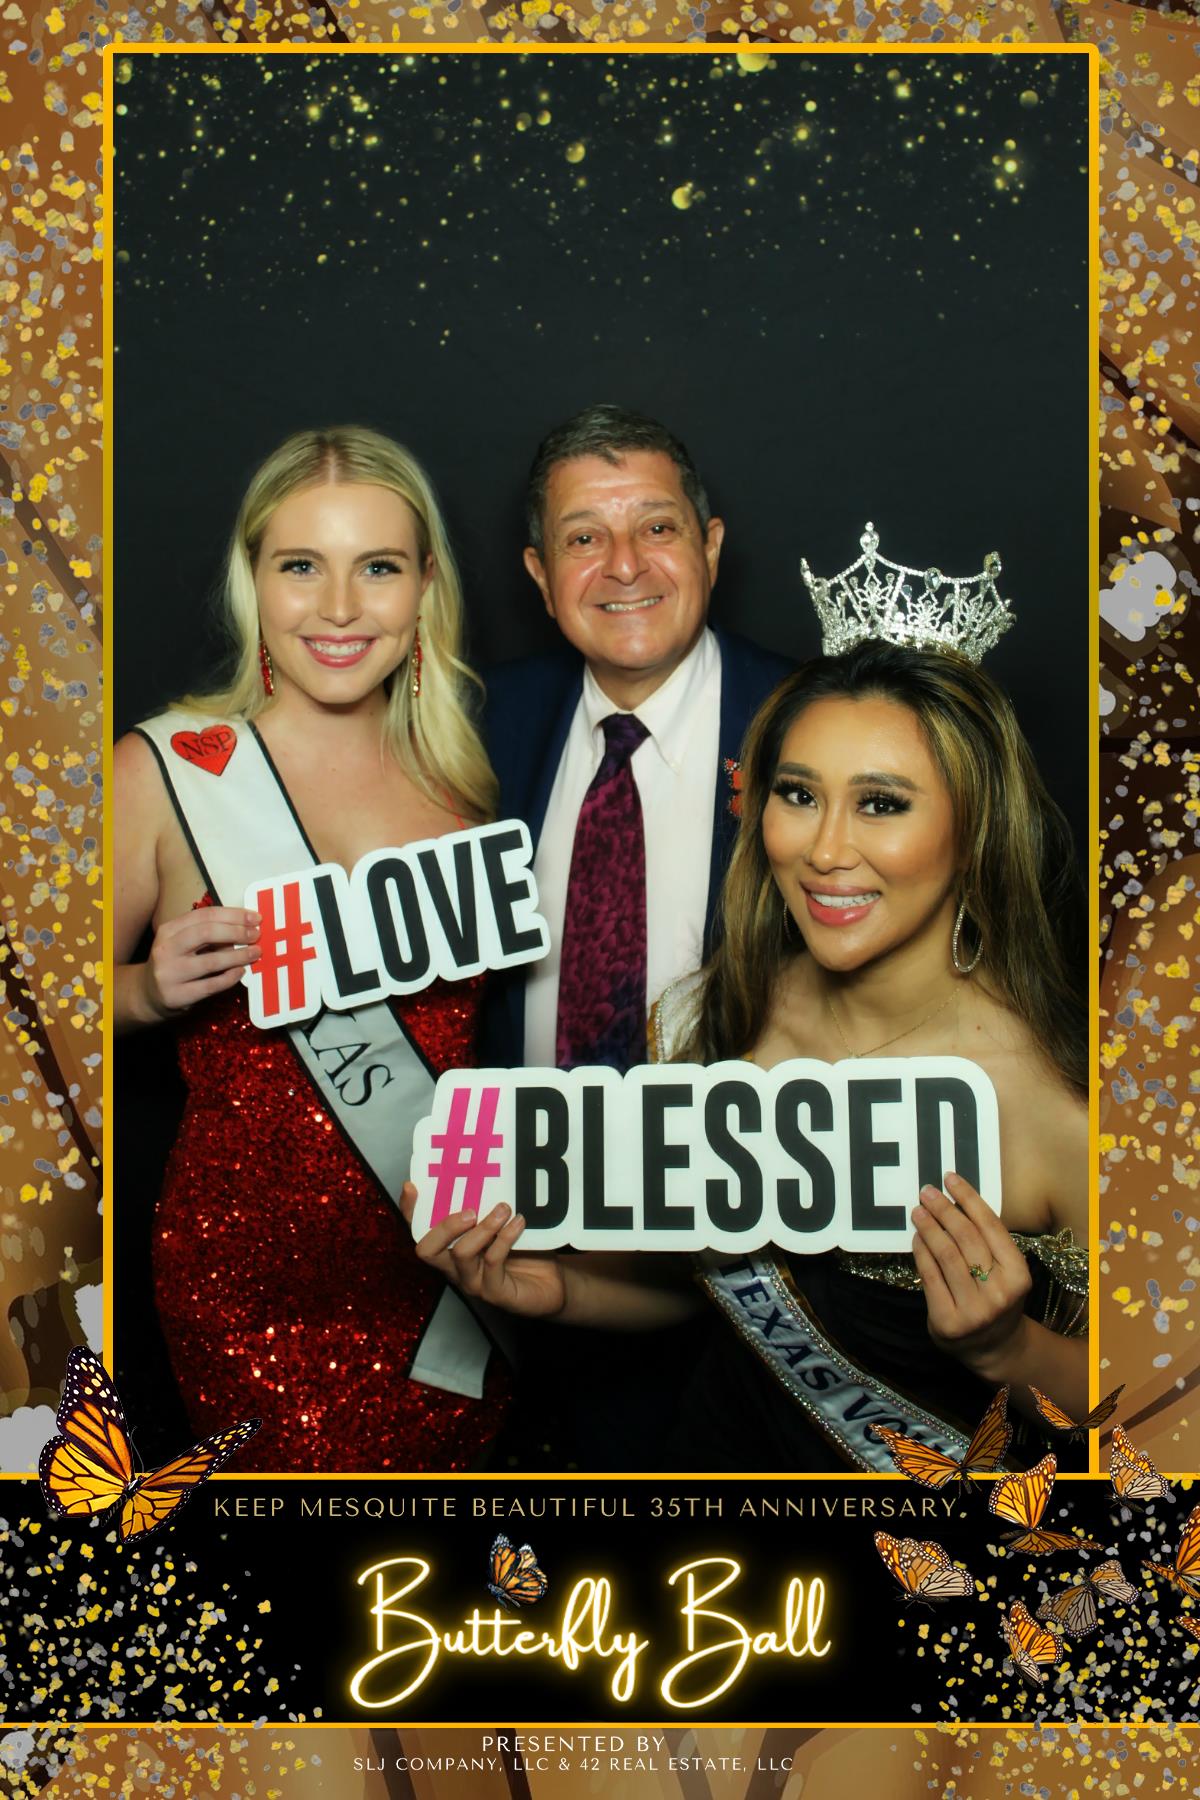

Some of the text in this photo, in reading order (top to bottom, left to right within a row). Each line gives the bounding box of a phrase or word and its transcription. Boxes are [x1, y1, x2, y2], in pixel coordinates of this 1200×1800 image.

[178, 731, 231, 760] NSP
[251, 828, 544, 1018] #LOVE
[300, 1007, 395, 1107] XAS
[428, 1077, 980, 1232] #BLESSED
[718, 1254, 842, 1391] TEXAS
